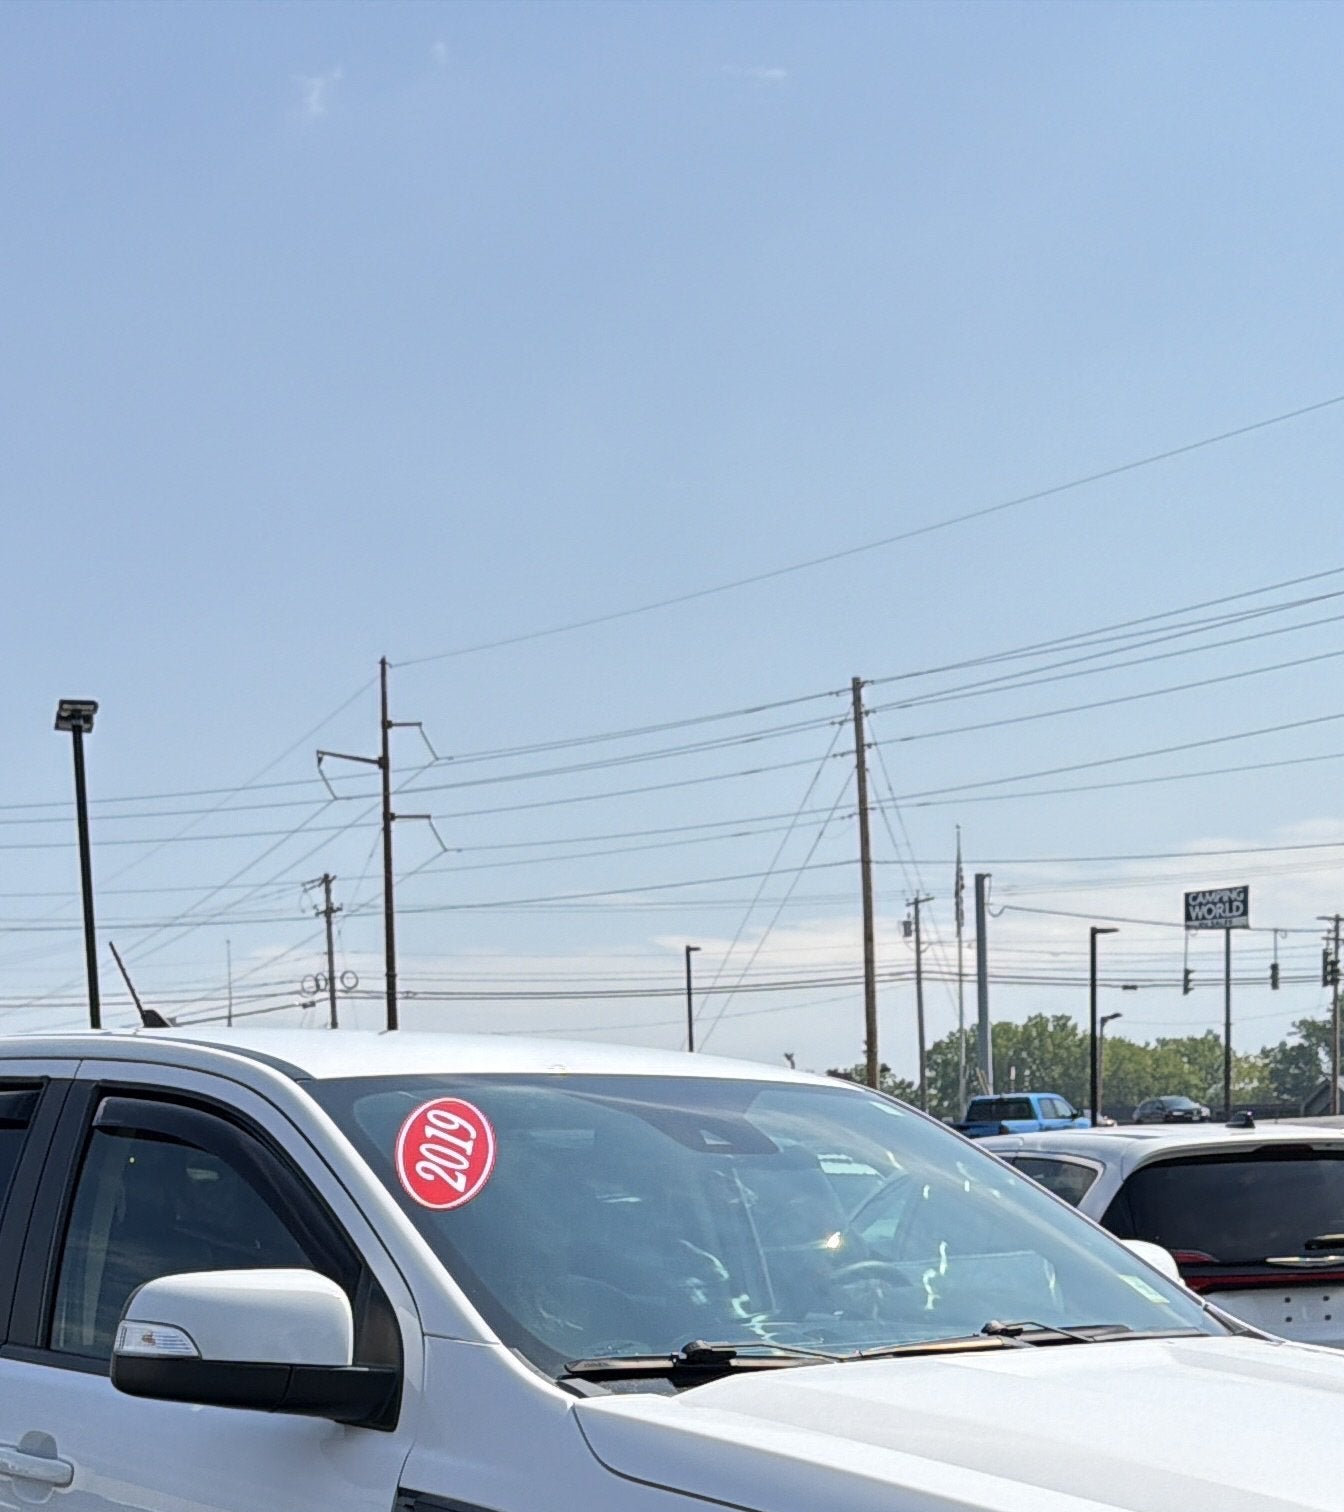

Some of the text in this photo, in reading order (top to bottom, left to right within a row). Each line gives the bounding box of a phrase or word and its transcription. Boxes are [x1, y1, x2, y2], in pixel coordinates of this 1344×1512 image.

[1188, 888, 1245, 905] CAMPING
[1189, 901, 1244, 920] WORLD
[415, 1109, 477, 1193] 2019
